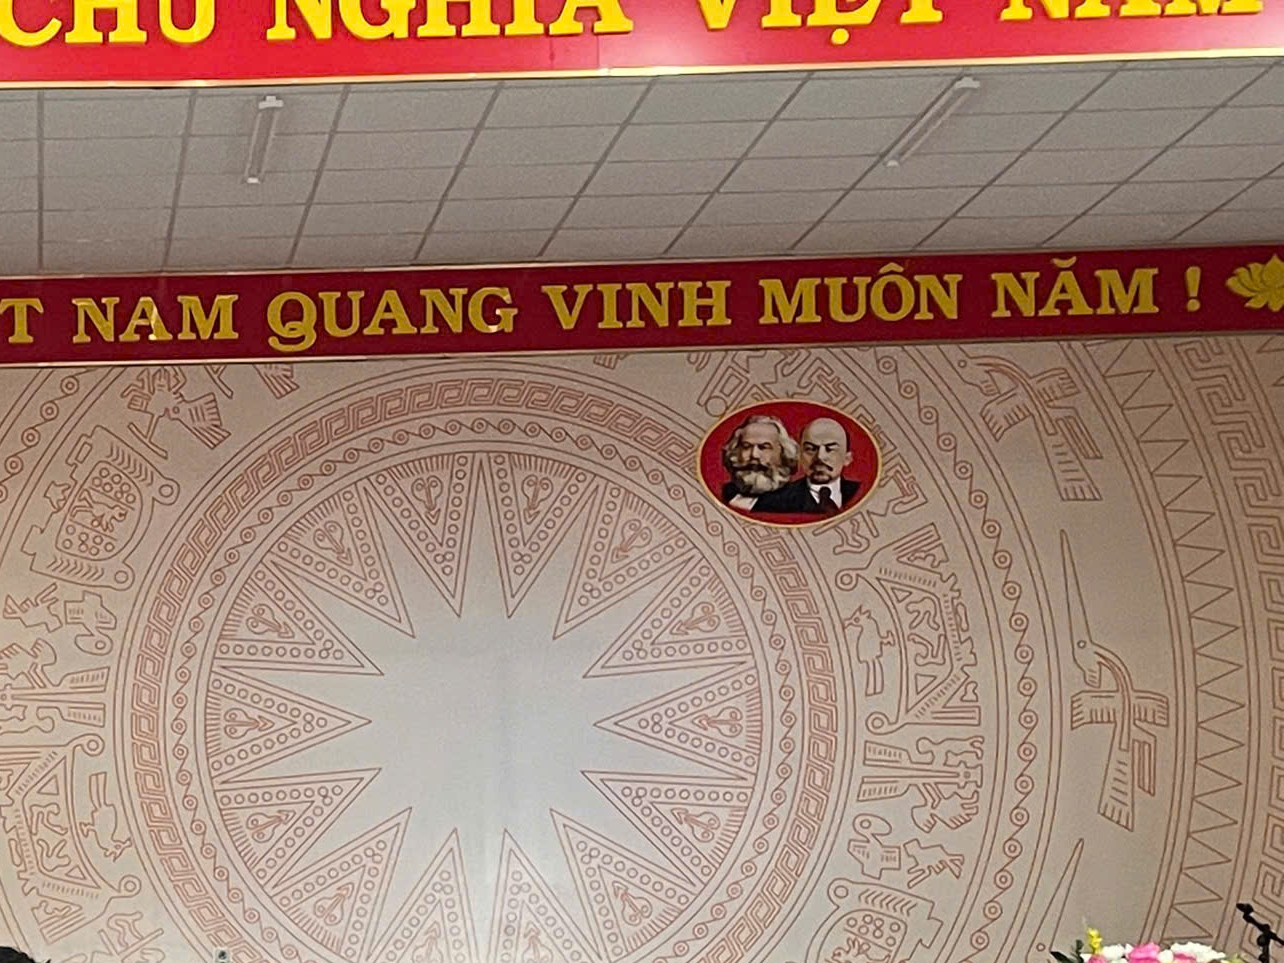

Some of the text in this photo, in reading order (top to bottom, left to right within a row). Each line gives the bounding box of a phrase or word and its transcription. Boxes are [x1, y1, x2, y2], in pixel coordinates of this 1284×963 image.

[72, 294, 240, 343] NAM
[266, 290, 518, 352] QUANG
[542, 280, 732, 330] VINH
[758, 263, 964, 324] MUÔN
[990, 255, 1159, 318] NĂM
